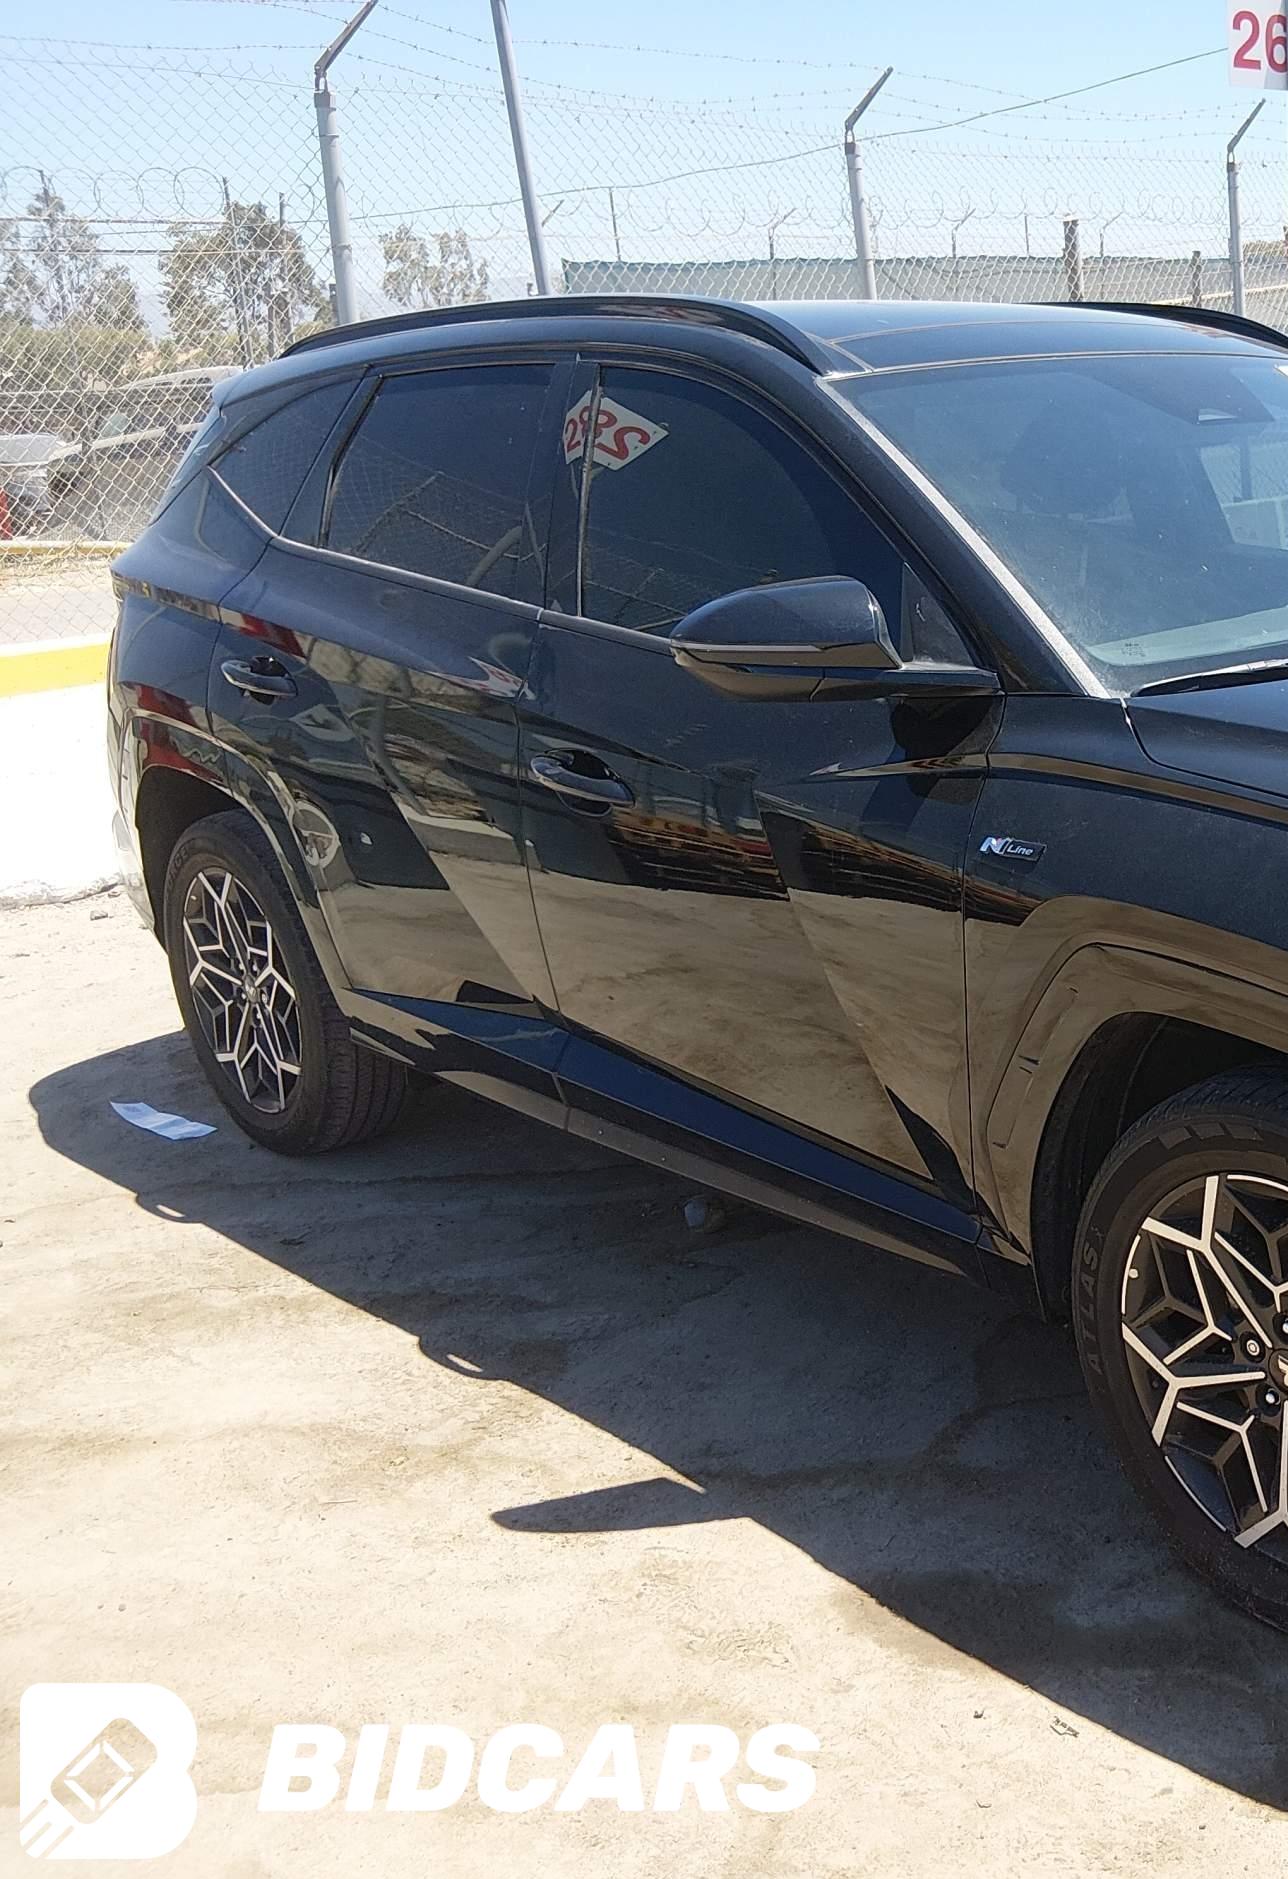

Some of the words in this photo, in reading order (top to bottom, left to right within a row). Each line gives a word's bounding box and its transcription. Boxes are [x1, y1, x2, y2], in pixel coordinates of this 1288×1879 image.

[1231, 10, 1288, 74] 26
[1006, 845, 1033, 855] Line
[1079, 1242, 1104, 1376] ATLAS
